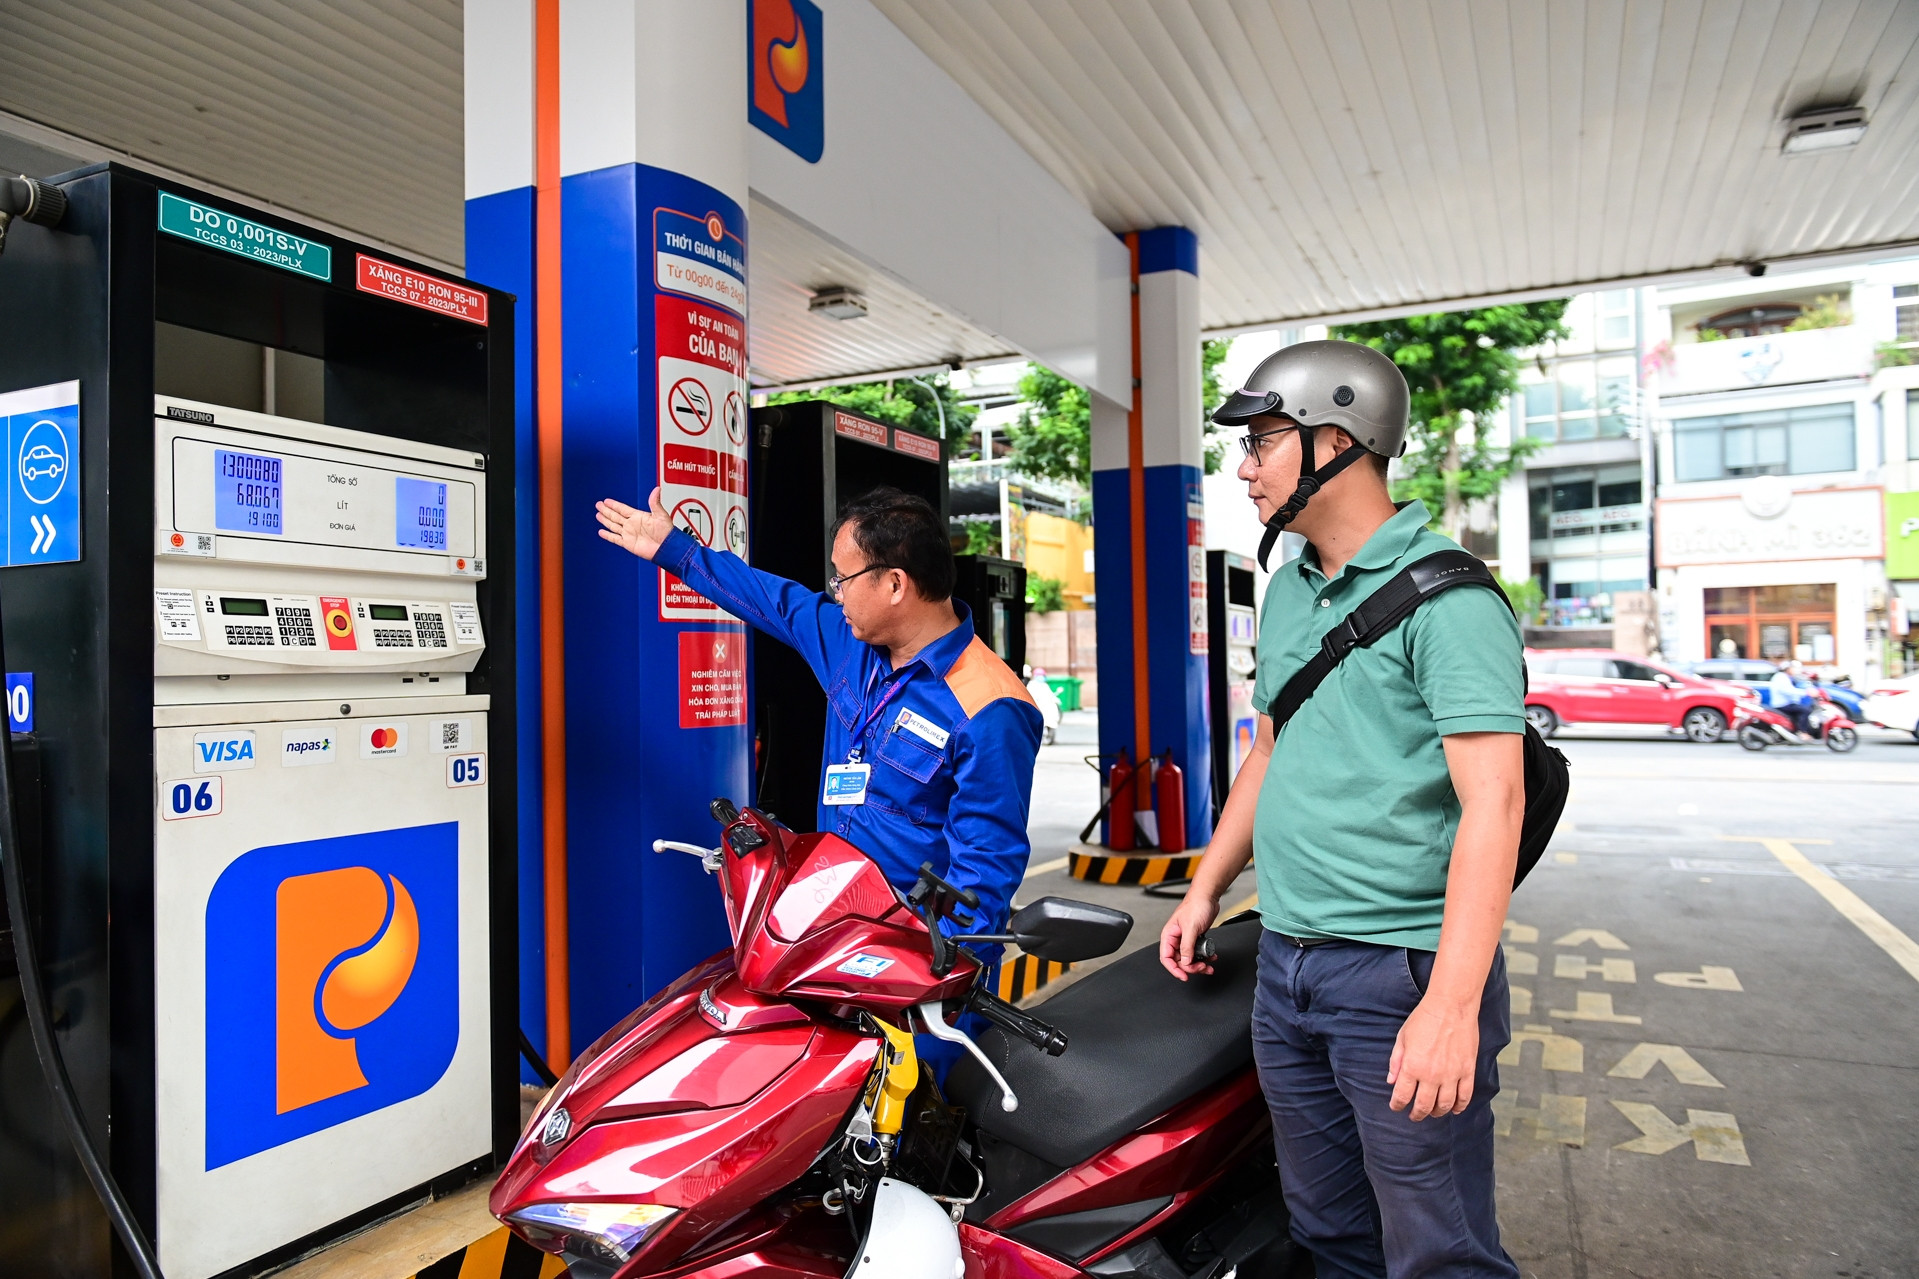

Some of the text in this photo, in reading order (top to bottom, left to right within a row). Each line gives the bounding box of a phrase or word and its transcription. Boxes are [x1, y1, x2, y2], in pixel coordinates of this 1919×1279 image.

[189, 205, 308, 256] DO 0,001S-V
[194, 227, 228, 245] TCCS
[230, 239, 244, 251] 03
[253, 246, 303, 269] 2023/PLX
[664, 231, 692, 252] THỜI
[694, 240, 716, 260] GIAN
[716, 249, 732, 269] BÁN
[368, 264, 479, 308] XĂNG E10 RON 95-III
[666, 263, 683, 279] Từ
[685, 269, 714, 288] 00g00
[381, 281, 408, 297] TCCS
[409, 290, 421, 301] 07
[428, 296, 468, 315] 2023/PLX
[687, 310, 739, 341] VÌ SỰ AN TOÀN
[688, 330, 739, 368] CỦA BẠN
[169, 406, 213, 422] TATSUNO
[223, 454, 280, 483] 1300080
[667, 458, 717, 476] CẤM HÚT THUỐC
[336, 499, 349, 511] LÍT
[438, 485, 445, 506] 0
[344, 523, 356, 532] GIÁ
[420, 530, 445, 545] 19830
[665, 593, 681, 605] ĐIỆN
[681, 595, 699, 605] THOẠI
[691, 669, 718, 679] NGHIÊM
[691, 684, 704, 692] XIN
[720, 683, 732, 692] MUA
[6, 684, 30, 723] 0
[688, 697, 704, 706] HÓA
[695, 710, 711, 719] TRÁI
[711, 709, 728, 718] PHÁP
[909, 718, 946, 743] PETROLIMEX
[195, 739, 254, 763] VISA
[286, 739, 321, 754] napas
[452, 757, 480, 783] 05
[172, 781, 213, 814] 06
[1494, 1089, 1751, 1167] KH
